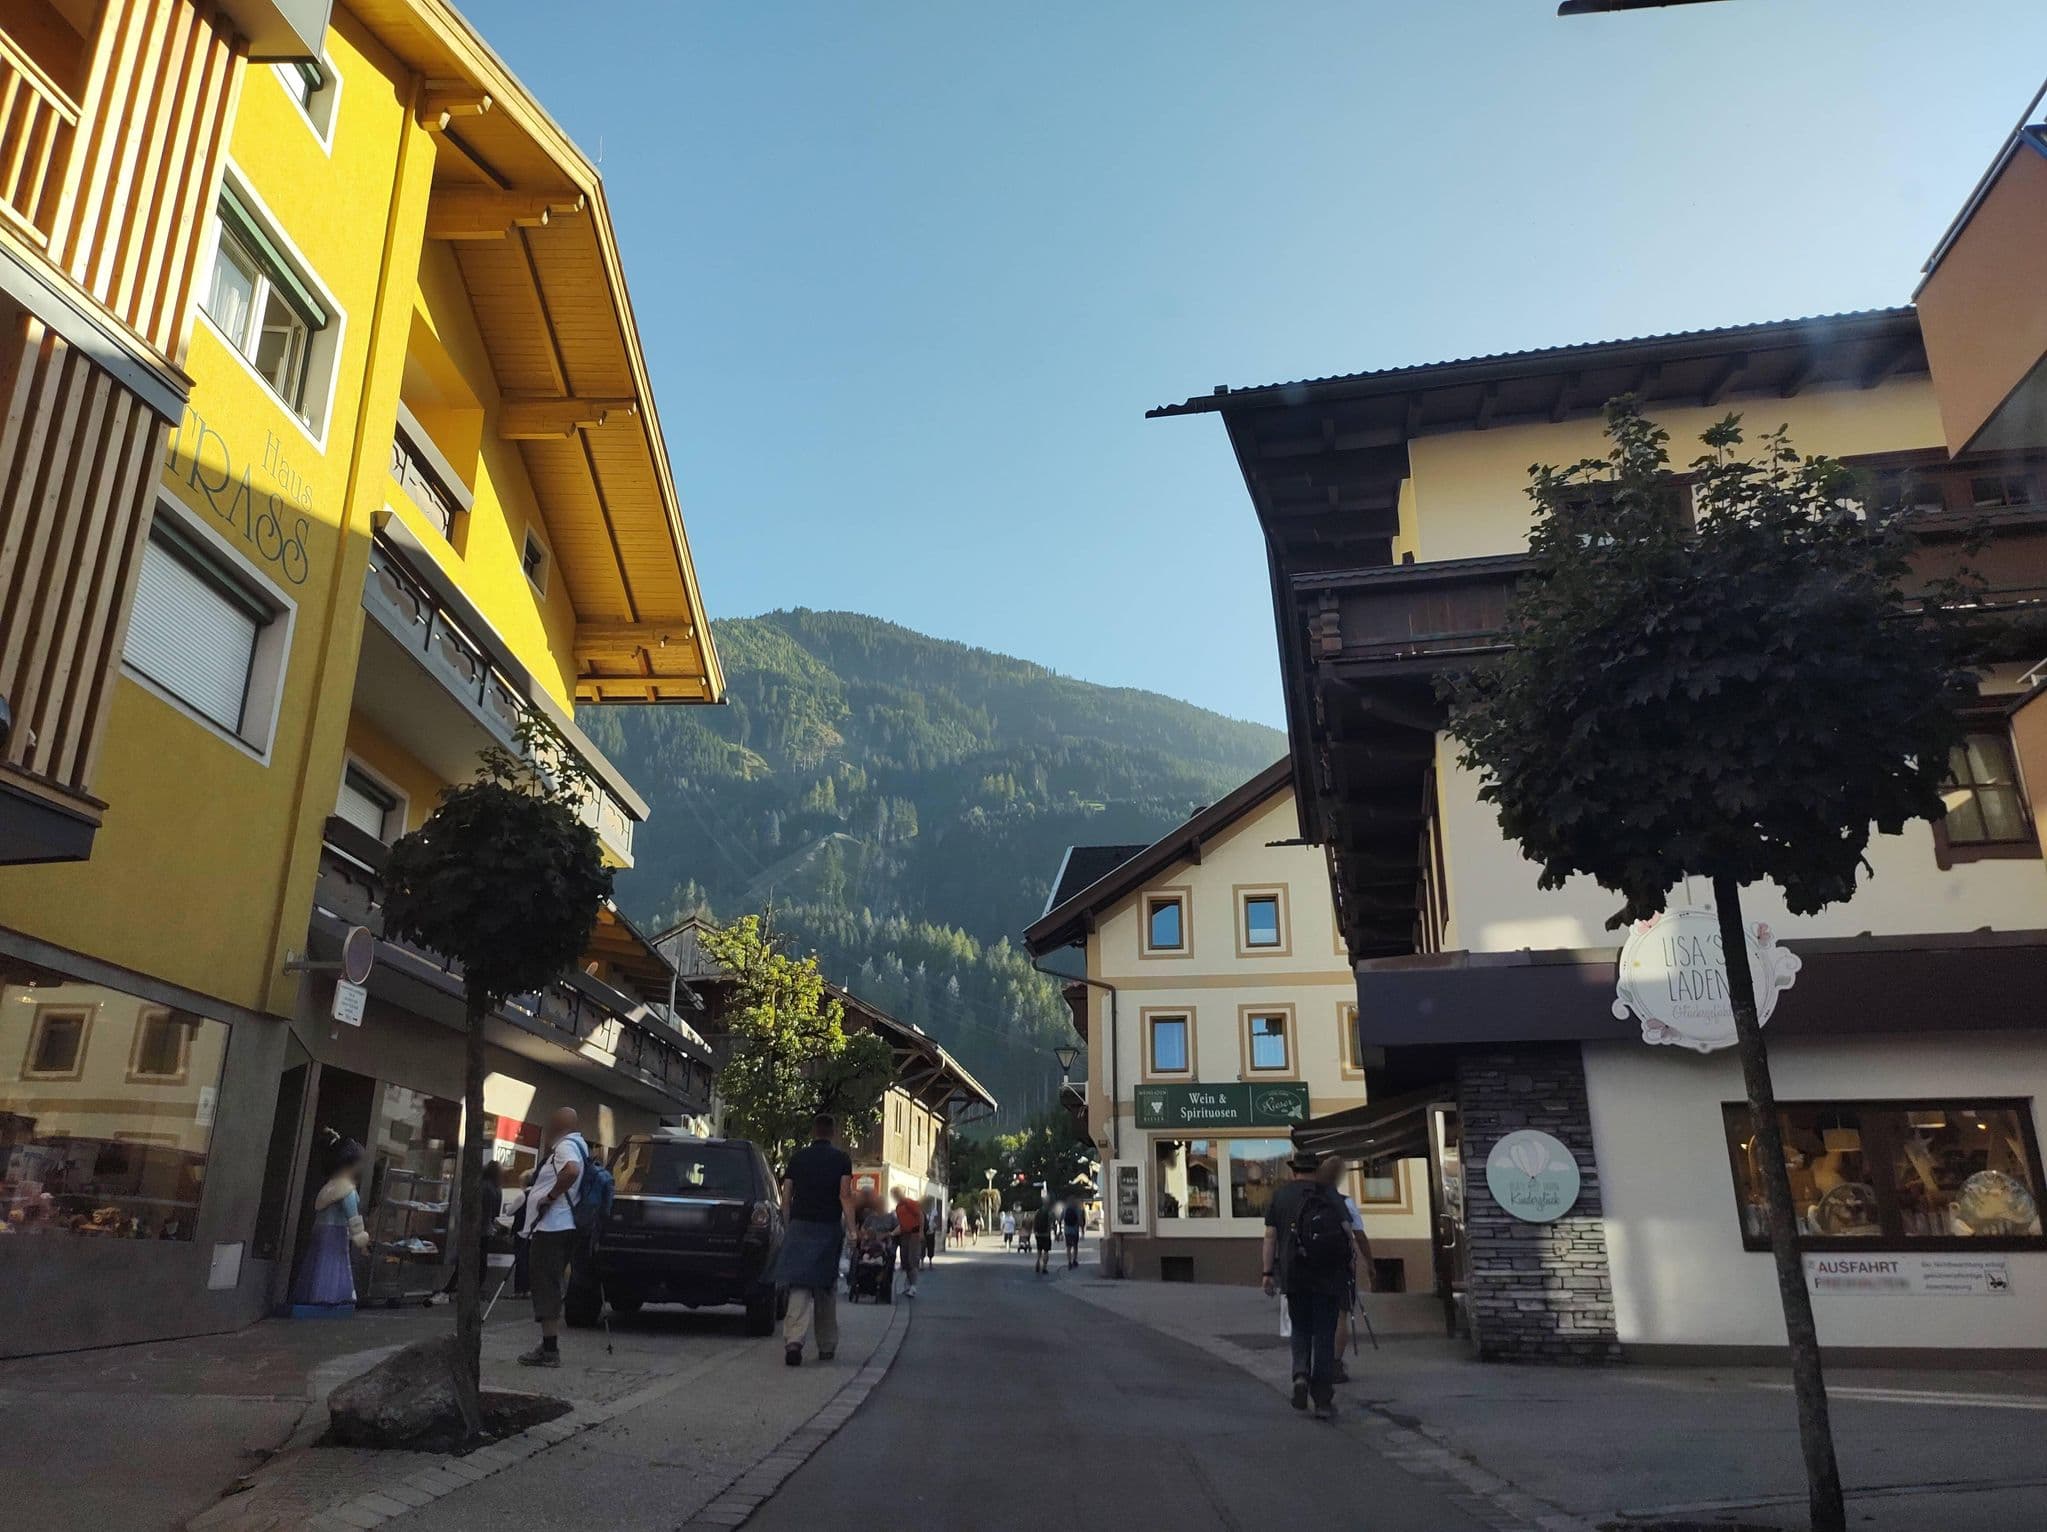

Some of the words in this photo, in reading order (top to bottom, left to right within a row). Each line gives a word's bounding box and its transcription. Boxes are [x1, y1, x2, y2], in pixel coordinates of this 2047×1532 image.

[261, 428, 313, 513] Haus
[1667, 968, 1731, 1001] LADEN
[1188, 1092, 1215, 1104] Wein
[1219, 1093, 1227, 1104] &
[1180, 1106, 1237, 1121] Spirituosen
[1818, 1261, 1899, 1274] AUSFAHRT
